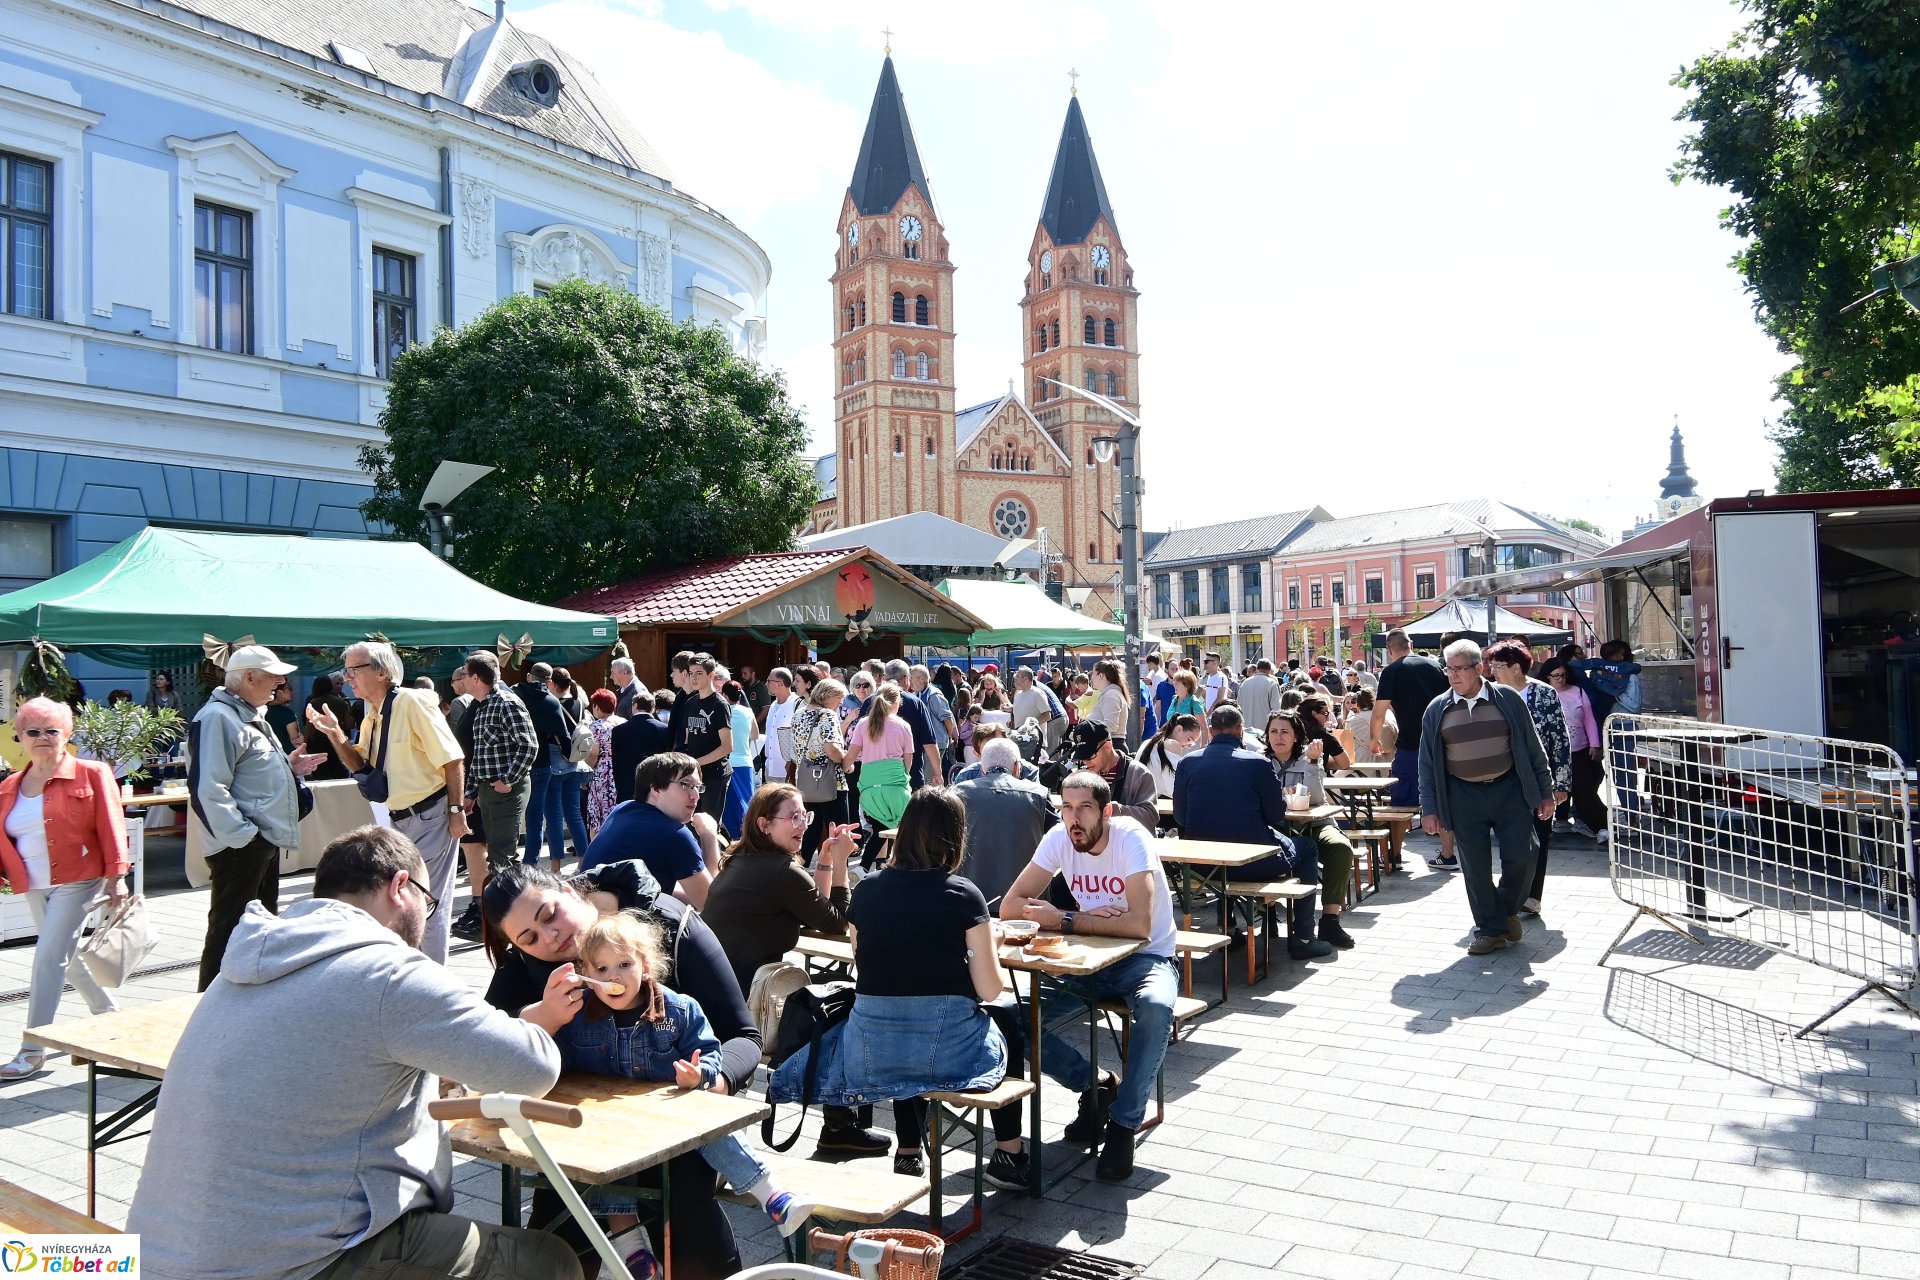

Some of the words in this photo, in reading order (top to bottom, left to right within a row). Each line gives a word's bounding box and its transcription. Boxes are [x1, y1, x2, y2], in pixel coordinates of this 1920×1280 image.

[776, 605, 832, 622] VINNAI
[923, 613, 939, 624] KFT.
[1700, 603, 1713, 723] ARBECUE
